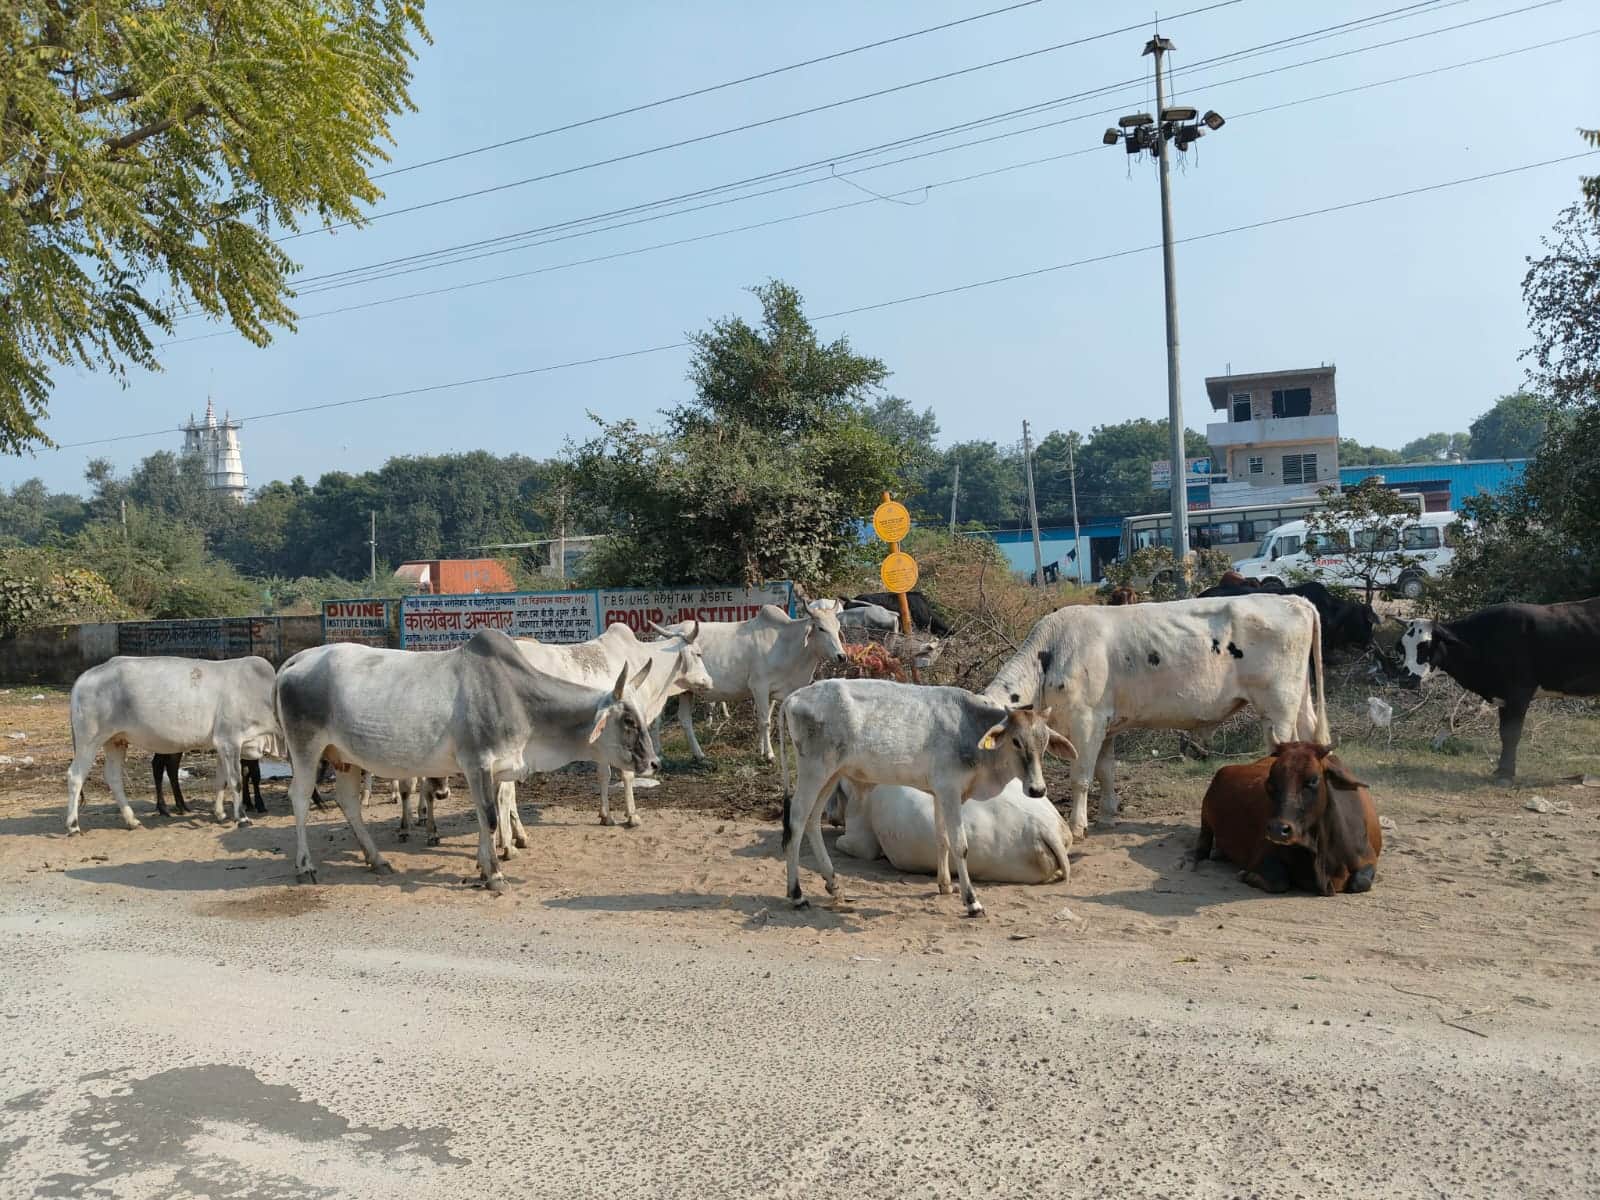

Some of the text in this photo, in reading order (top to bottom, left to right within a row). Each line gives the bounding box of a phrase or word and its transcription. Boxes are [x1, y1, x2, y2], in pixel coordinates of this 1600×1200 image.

[654, 591, 694, 604] ROHTAK
[326, 603, 385, 617] DIVINE
[463, 611, 513, 630] अस्पताल
[605, 608, 664, 632] GROUP
